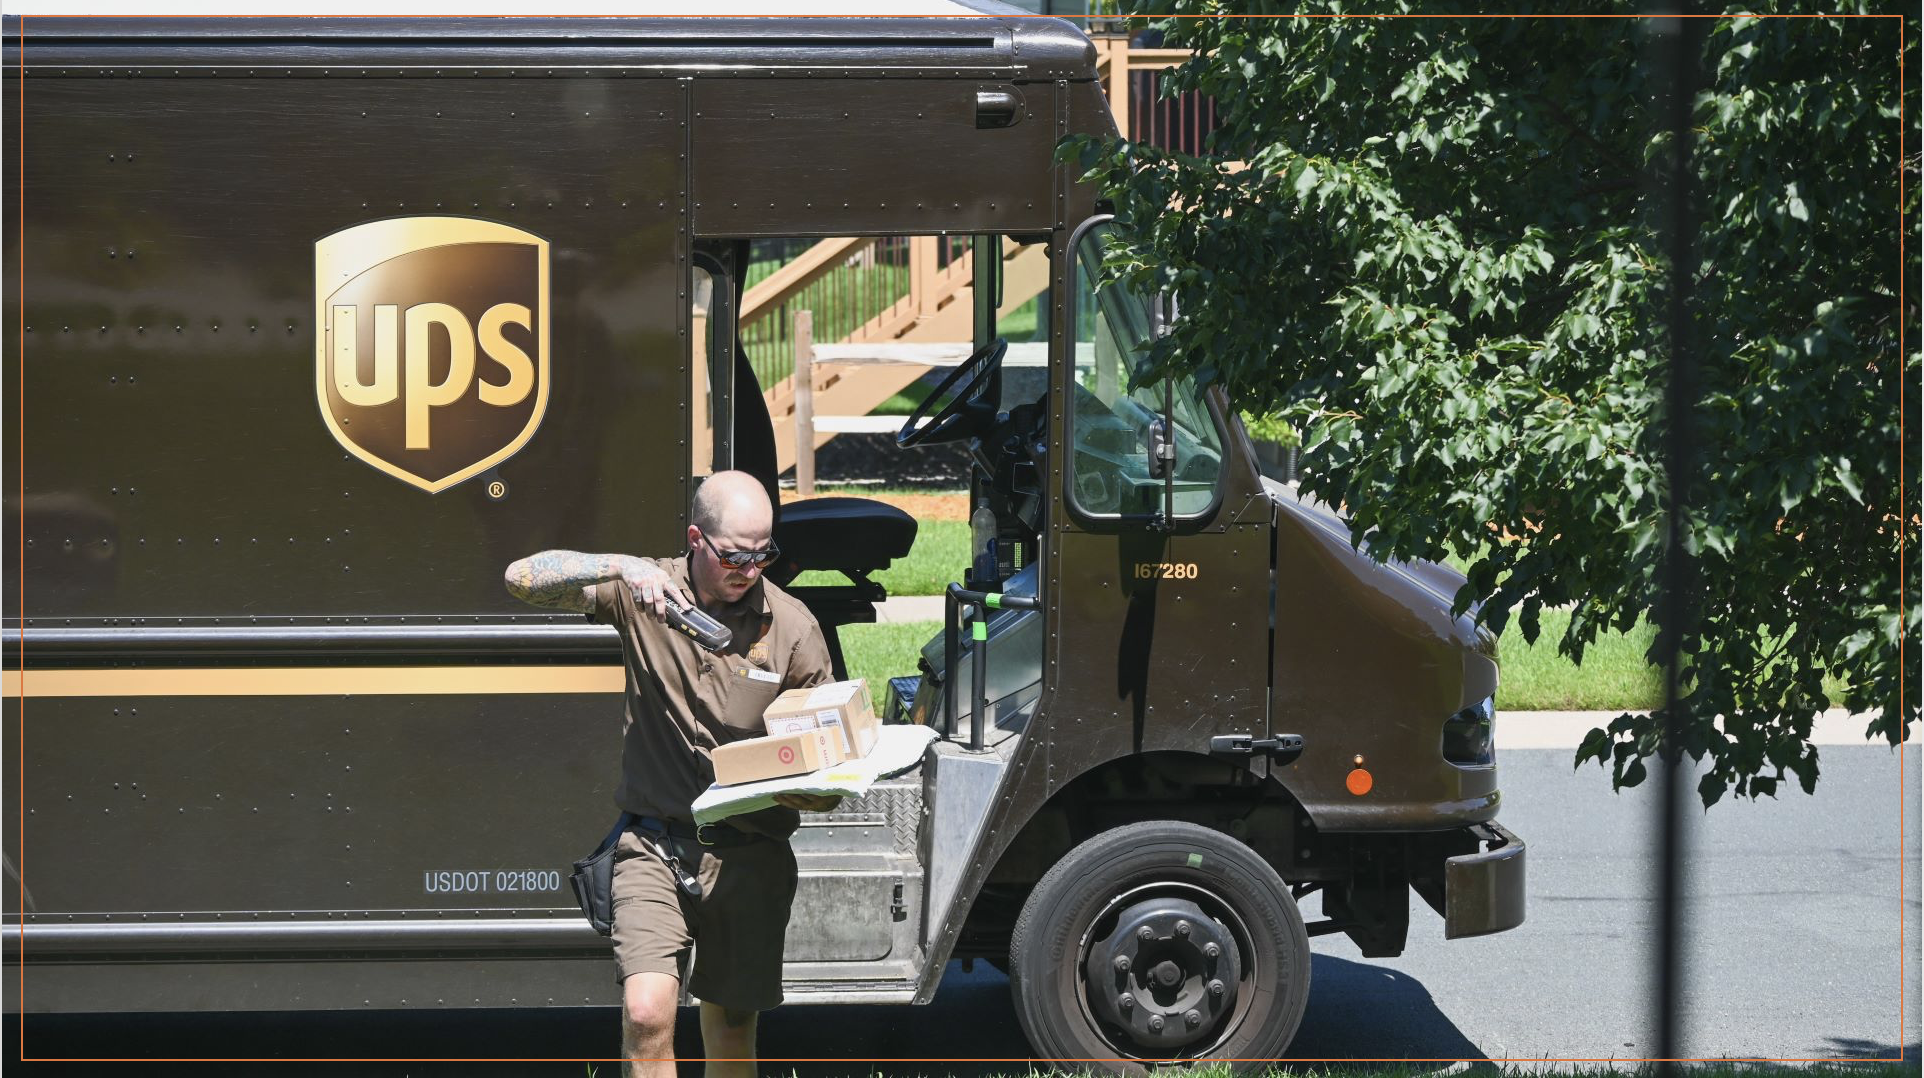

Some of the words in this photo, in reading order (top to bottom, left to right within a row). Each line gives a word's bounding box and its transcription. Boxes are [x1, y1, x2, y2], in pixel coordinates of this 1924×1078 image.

[333, 302, 535, 450] ups
[425, 871, 491, 892] USDOT
[496, 870, 560, 891] 021800
